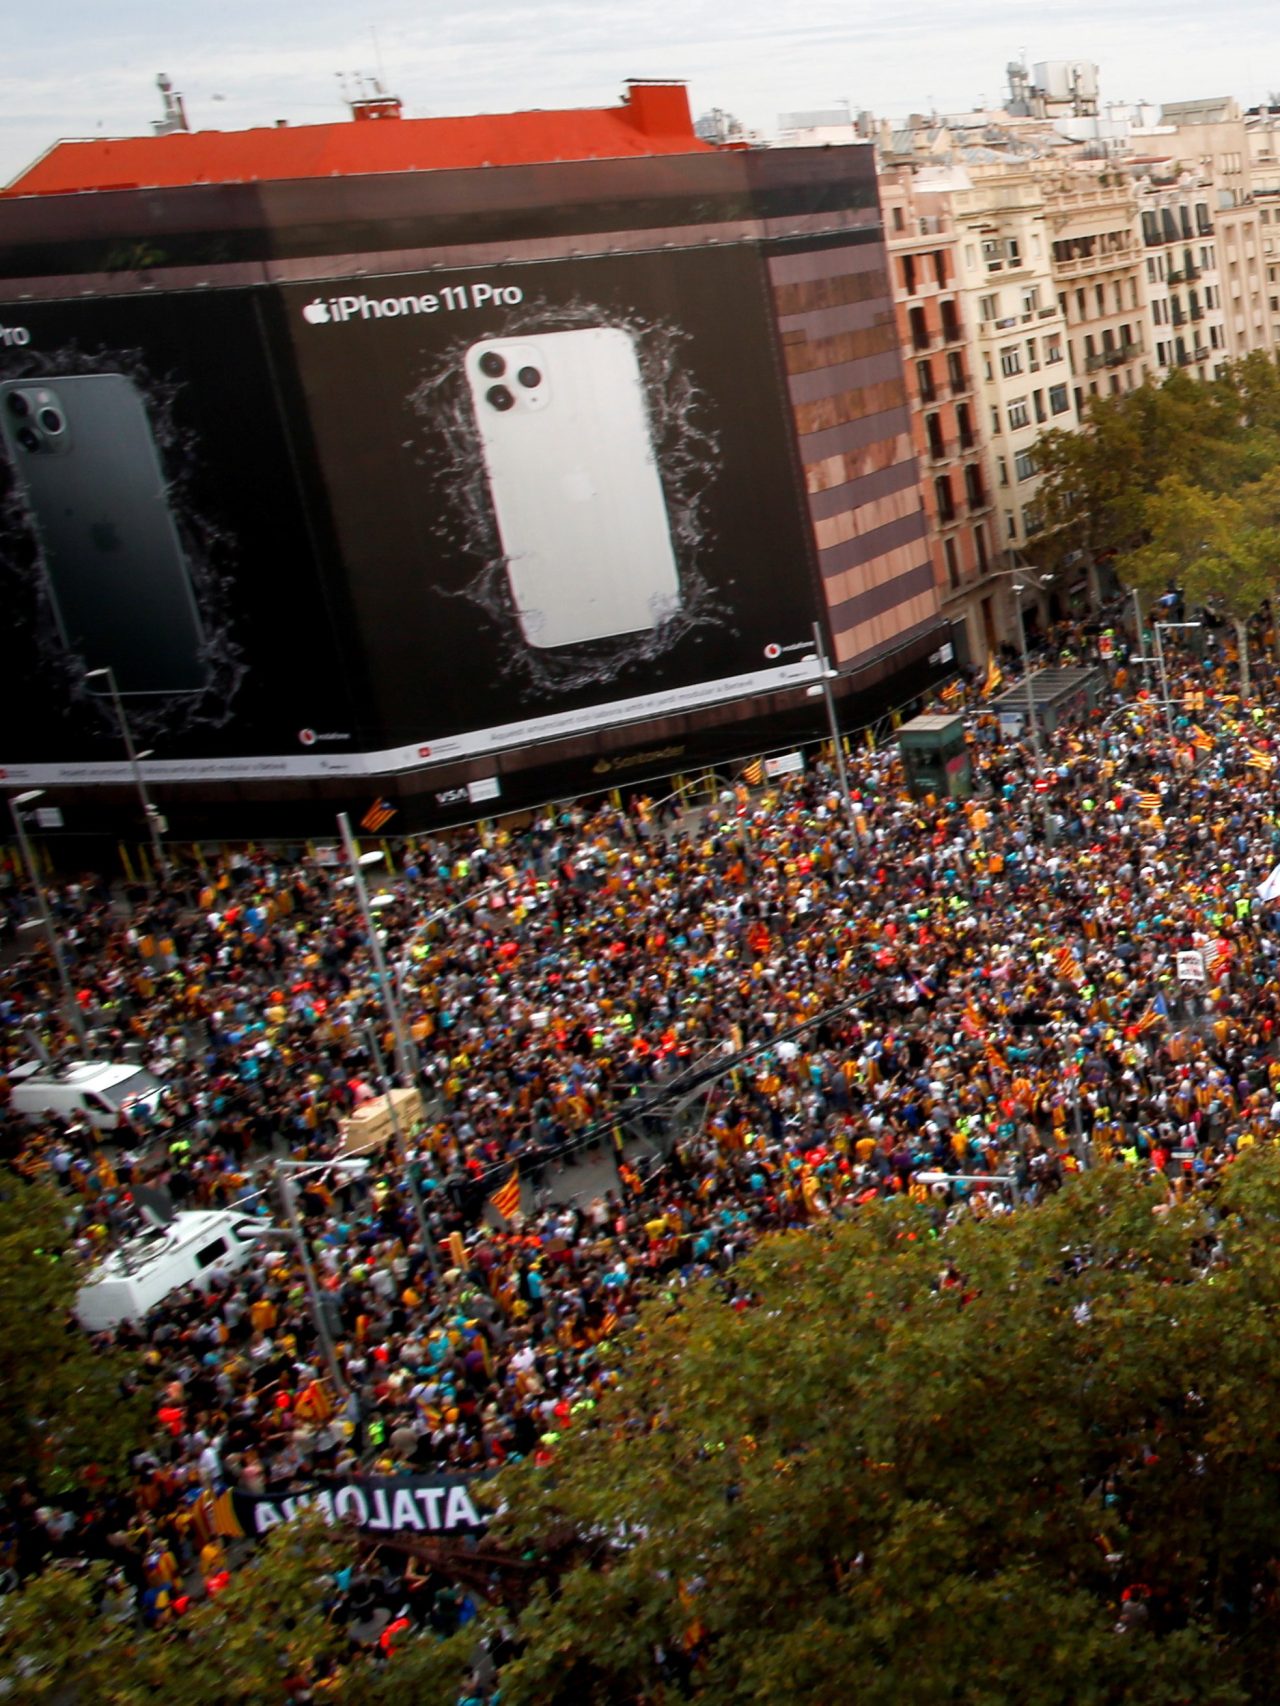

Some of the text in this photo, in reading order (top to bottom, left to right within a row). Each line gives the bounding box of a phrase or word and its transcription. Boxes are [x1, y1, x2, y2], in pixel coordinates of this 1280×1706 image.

[328, 282, 523, 323] iPhone 11 Pro
[0, 320, 30, 347] ro
